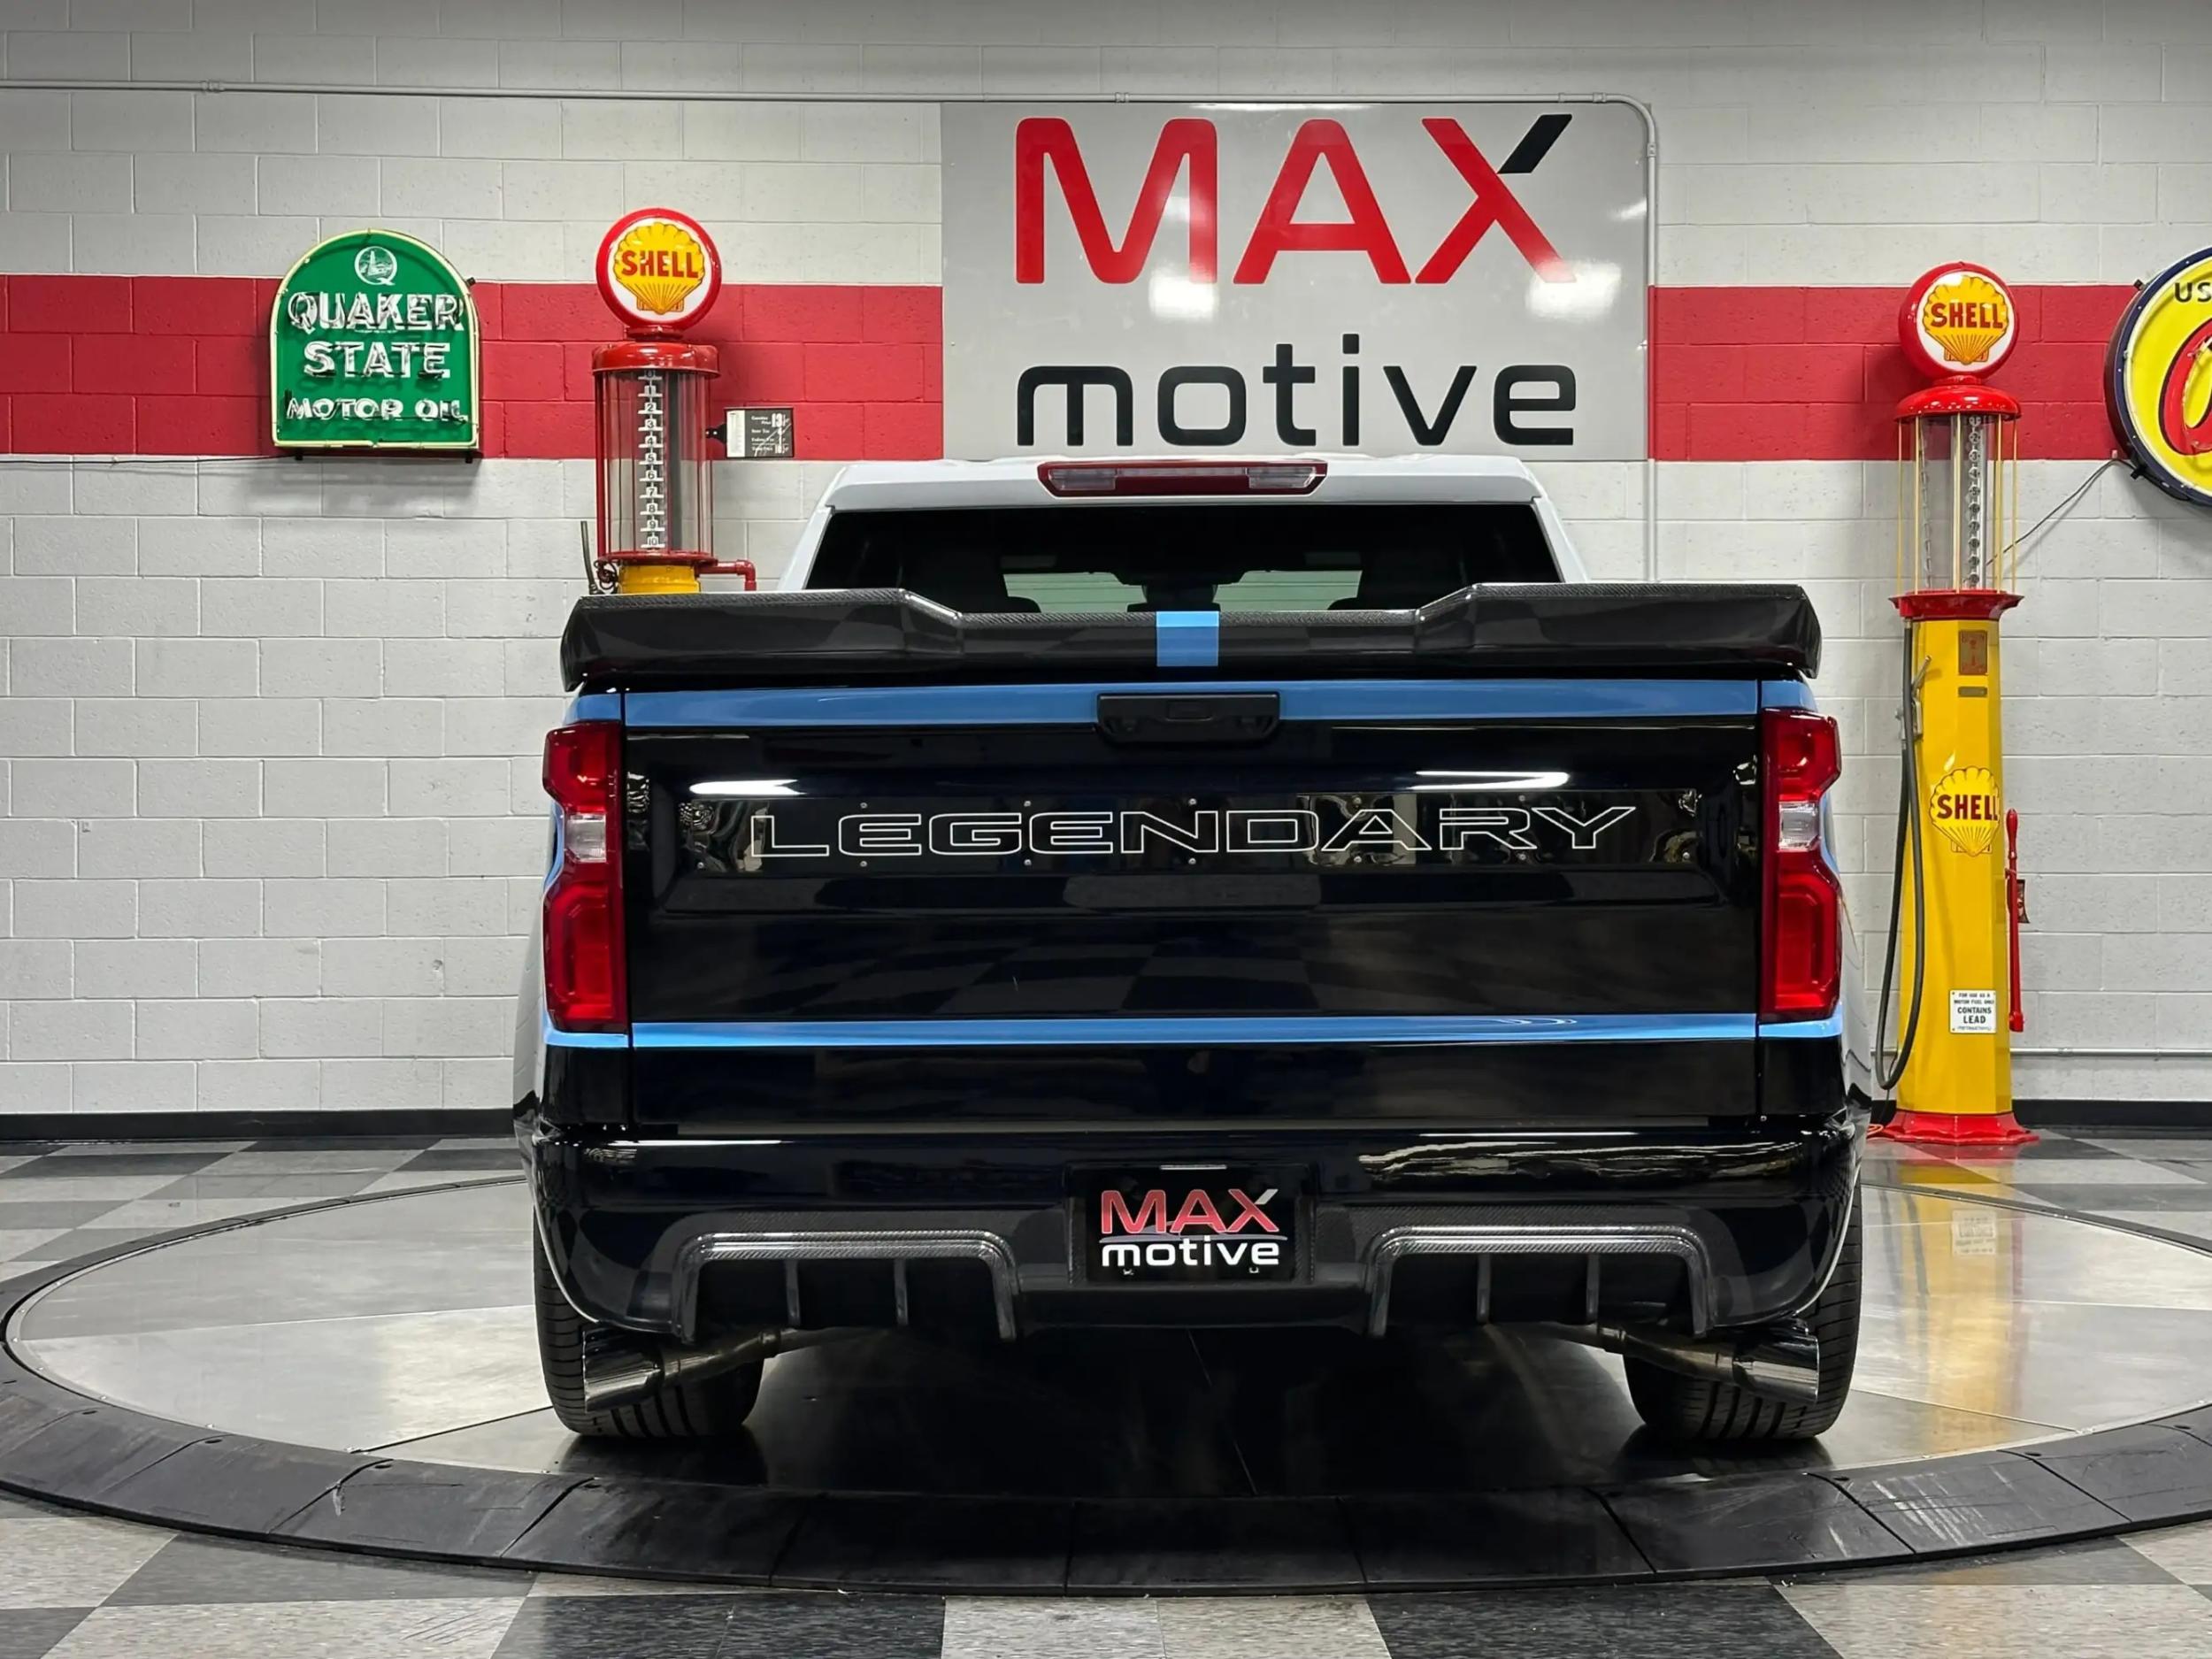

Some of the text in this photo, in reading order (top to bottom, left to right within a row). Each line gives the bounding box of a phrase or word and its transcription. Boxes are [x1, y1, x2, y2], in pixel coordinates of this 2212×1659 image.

[1015, 113, 1577, 284] MAX
[621, 250, 699, 279] SHELL
[288, 292, 465, 334] QUAKER
[1930, 302, 2004, 329] SHELL
[303, 341, 450, 379] STATE
[1017, 334, 1577, 447] motive
[287, 397, 469, 422] MOTOR OIL
[1937, 794, 1998, 821] SHELL
[751, 806, 1636, 856] LEGENDARY
[1963, 1015, 1986, 1024] LEAD
[1101, 1188, 1279, 1234] MAX
[1102, 1234, 1279, 1267] motive
